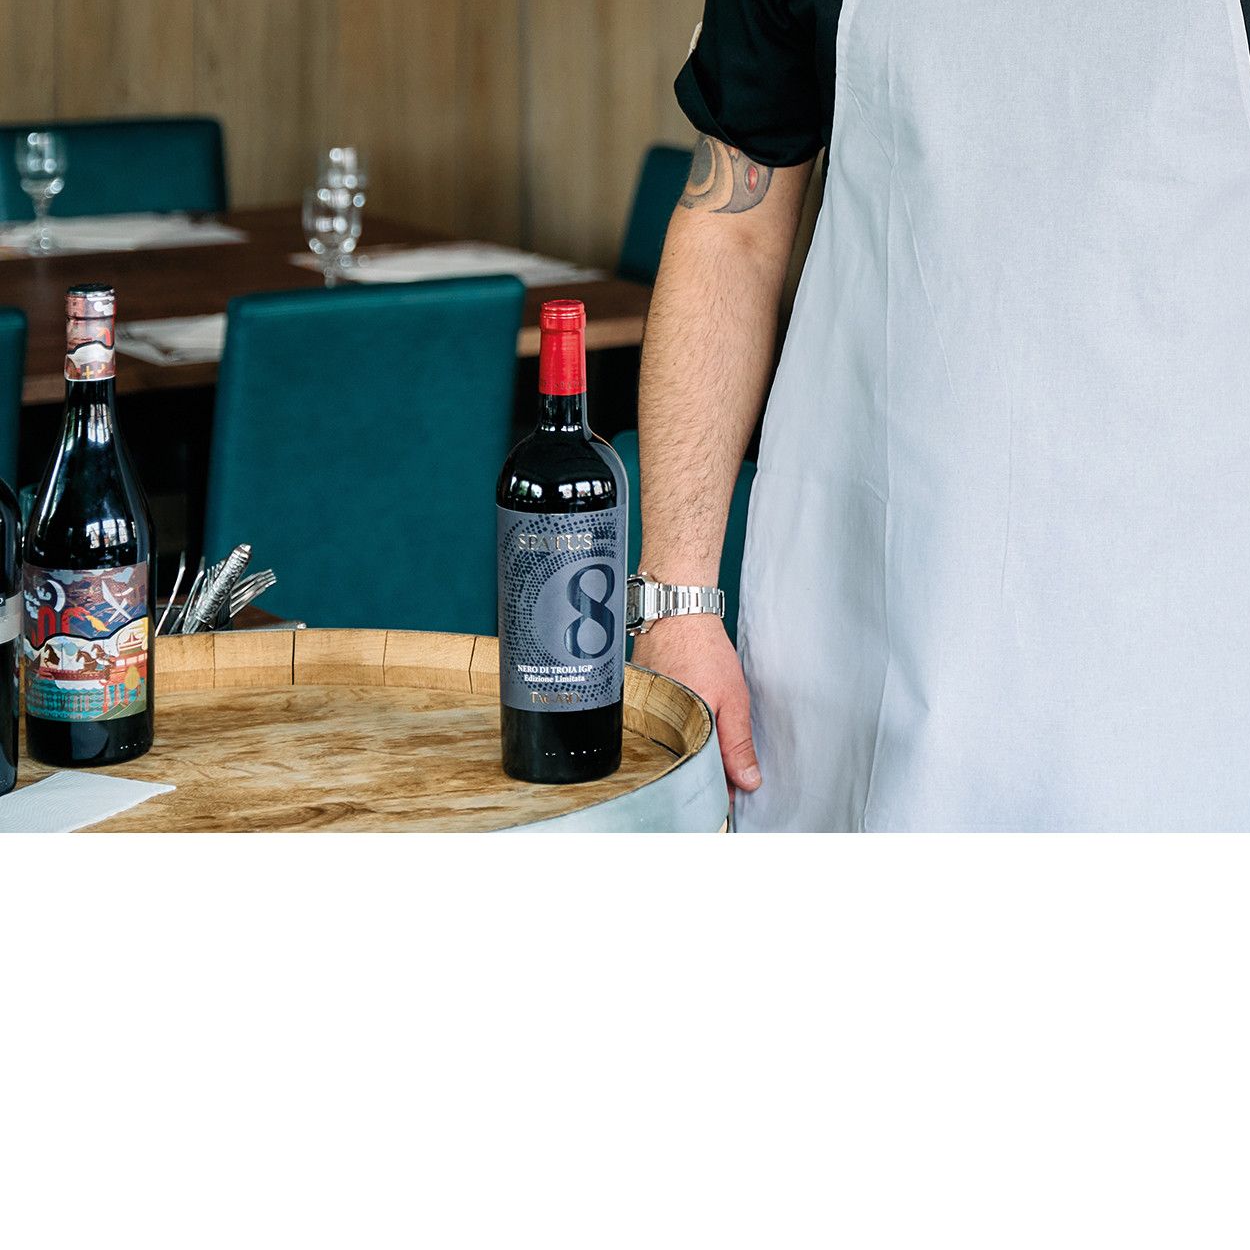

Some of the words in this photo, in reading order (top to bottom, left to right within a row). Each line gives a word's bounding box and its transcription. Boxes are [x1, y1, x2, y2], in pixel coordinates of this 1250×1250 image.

[518, 533, 593, 551] SPATUS
[564, 563, 615, 659] 8
[517, 665, 539, 674] NERO
[540, 666, 549, 674] DI
[551, 666, 578, 674] TROIA
[578, 665, 594, 673] IGP
[524, 674, 554, 683] Edizione
[555, 675, 586, 683] Limitata
